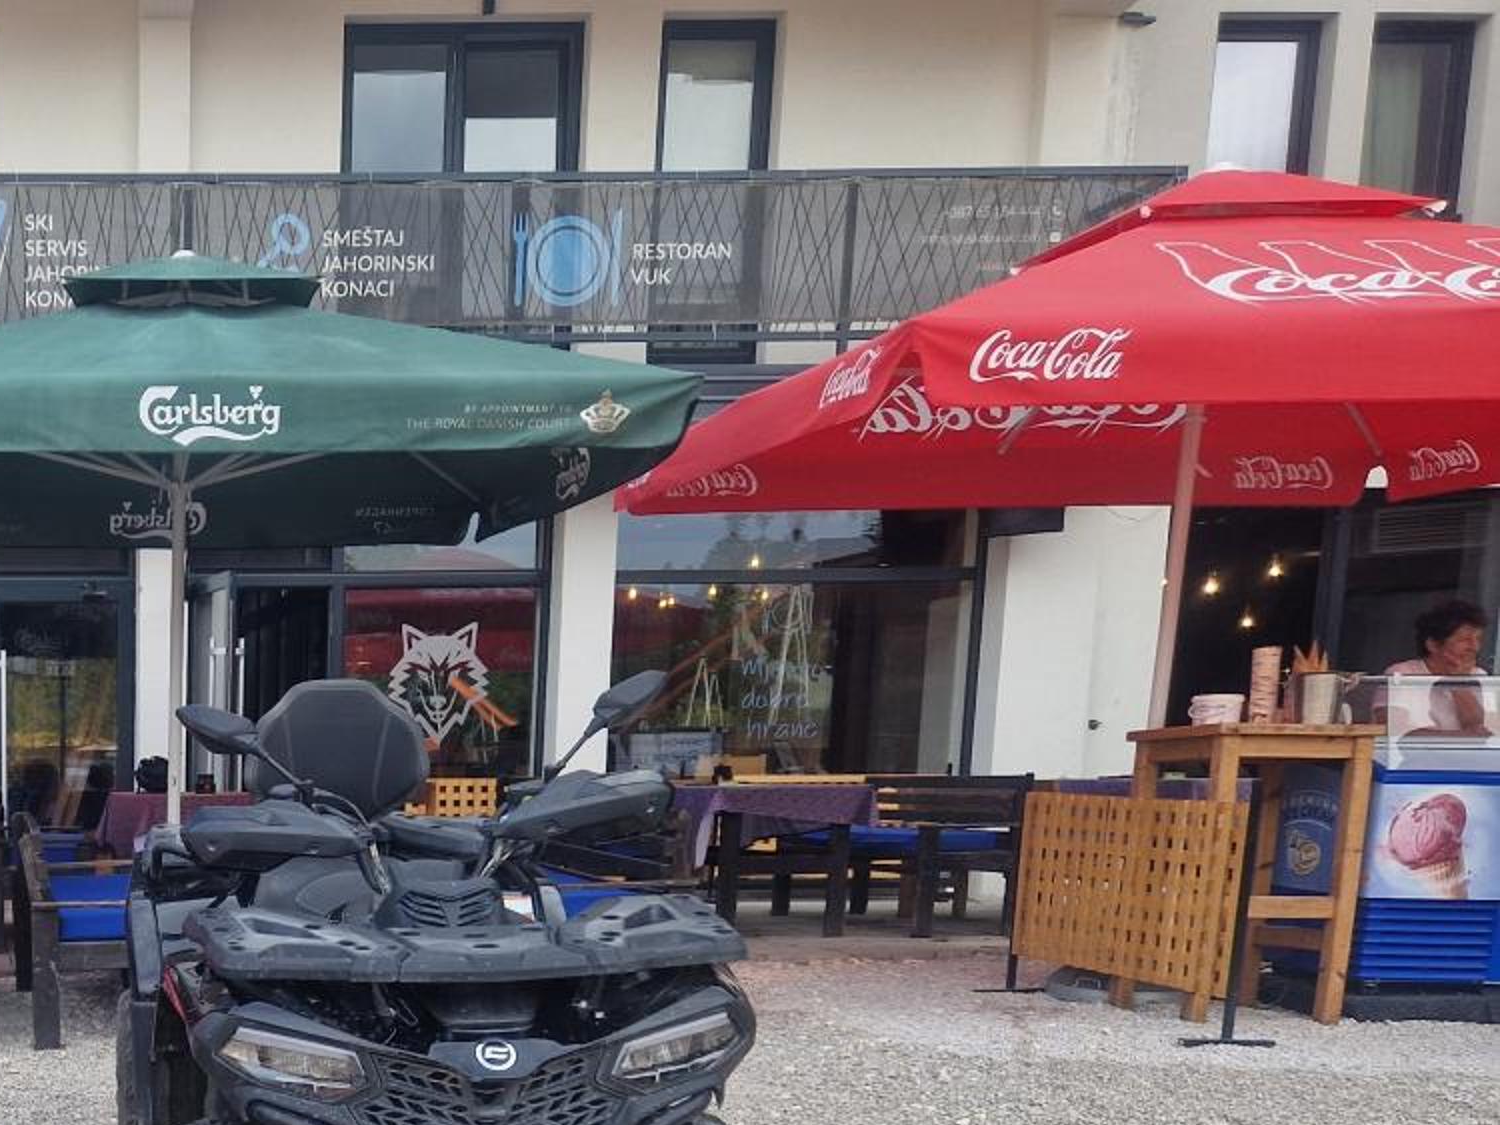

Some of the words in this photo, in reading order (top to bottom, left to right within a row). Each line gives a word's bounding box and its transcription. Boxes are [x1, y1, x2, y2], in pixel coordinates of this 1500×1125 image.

[25, 213, 53, 232] SKI
[322, 226, 404, 250] SMEŠTAJ
[25, 240, 88, 257] SERVIS
[632, 242, 732, 259] RESTORAN
[321, 253, 435, 275] JAHORINSKI
[631, 267, 672, 285] VUK
[320, 279, 395, 298] KONACI
[969, 328, 1133, 382] Coca-Cola
[139, 385, 282, 440] Carlsberg
[406, 417, 429, 429] THE
